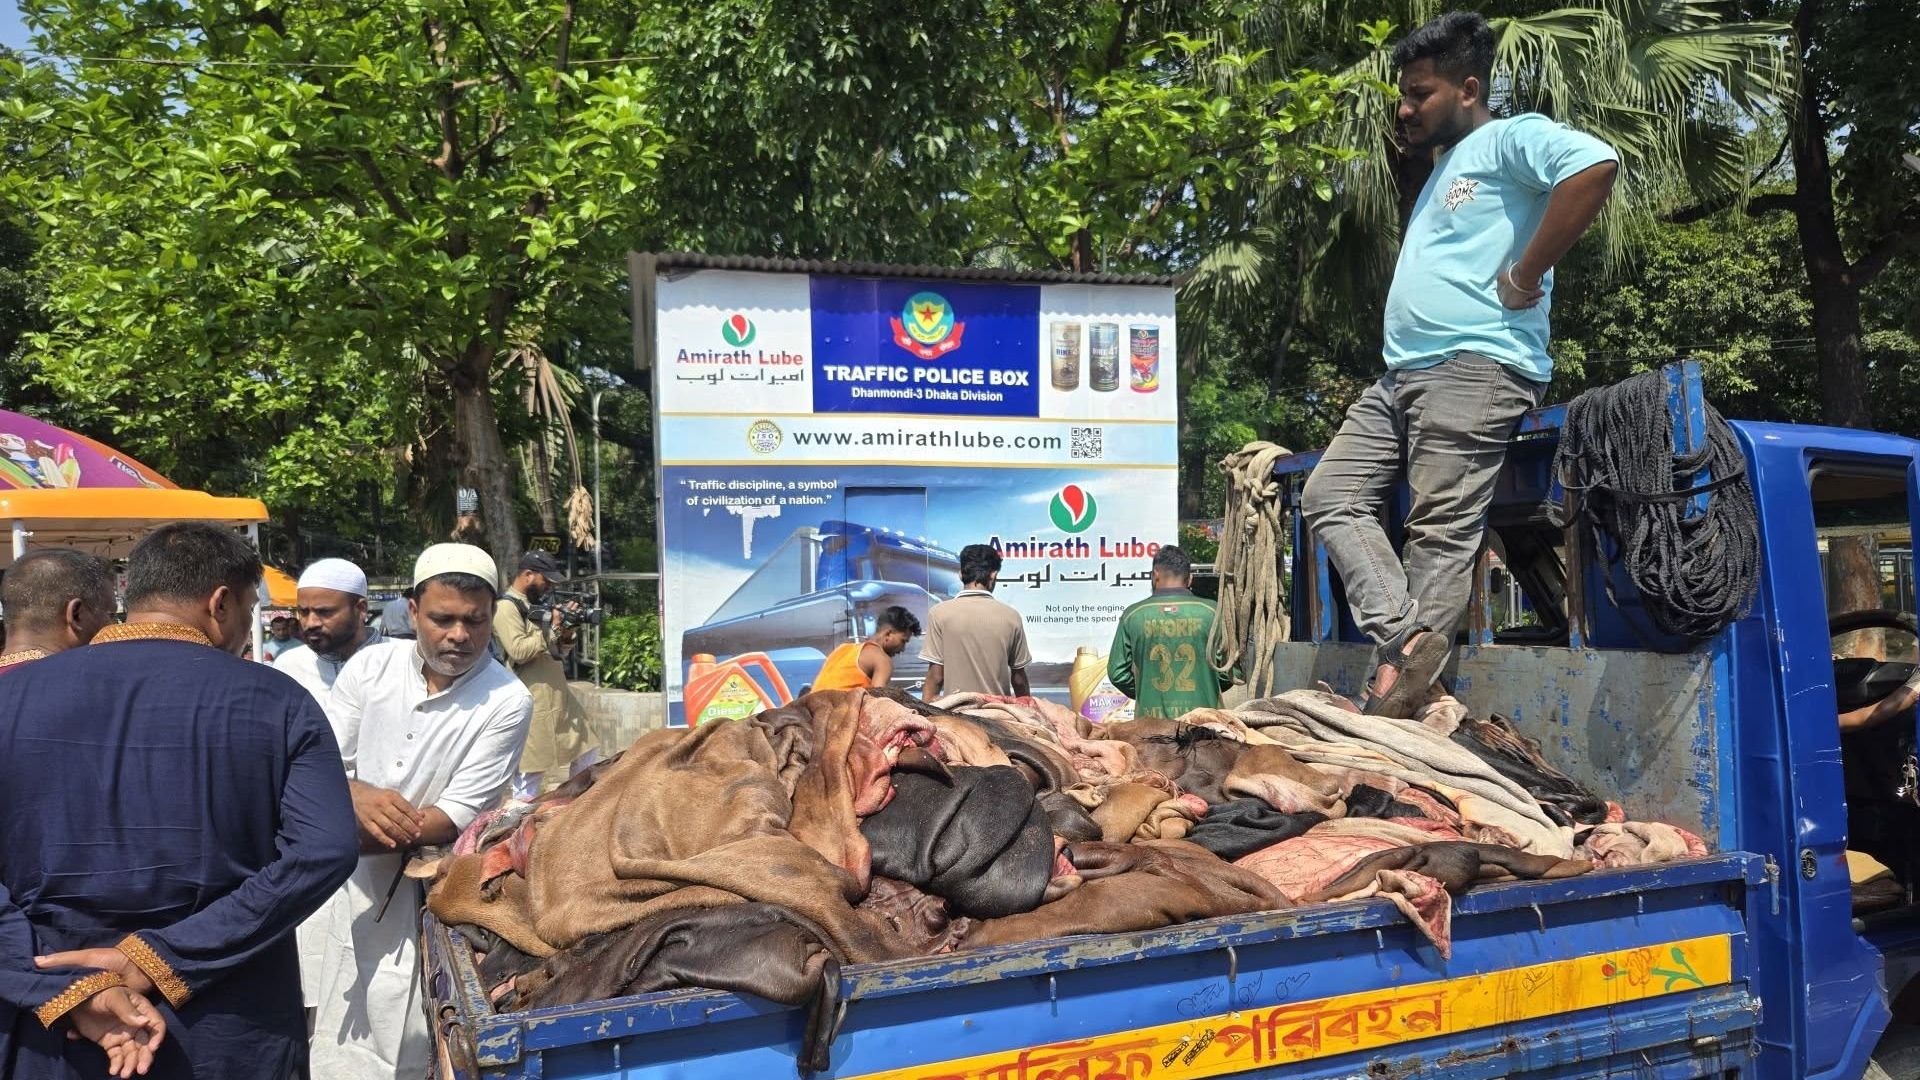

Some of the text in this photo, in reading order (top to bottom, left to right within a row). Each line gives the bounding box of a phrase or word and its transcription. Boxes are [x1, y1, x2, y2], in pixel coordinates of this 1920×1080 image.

[677, 349, 803, 365] Amirath Lube
[823, 365, 1029, 386] TRAFFIC POLICE BOX
[852, 387, 1003, 401] Dhanmondi-3 Dhaka Division
[793, 429, 1062, 449] www.amirathlube.com
[728, 480, 786, 492] discipline,
[789, 482, 795, 490] a
[797, 480, 838, 492] symbol
[687, 496, 698, 505] of
[702, 495, 762, 506] civilization
[765, 495, 776, 505] of
[779, 497, 786, 505] a
[990, 536, 1160, 558] Amirath Lube
[1060, 562, 1153, 588] ميرات
[1045, 604, 1060, 612] Not
[1062, 604, 1079, 613] only
[1082, 604, 1095, 612] the
[1044, 615, 1073, 624] change
[1091, 615, 1117, 624] speed
[1151, 643, 1196, 692] 32
[708, 706, 746, 716] Diesel
